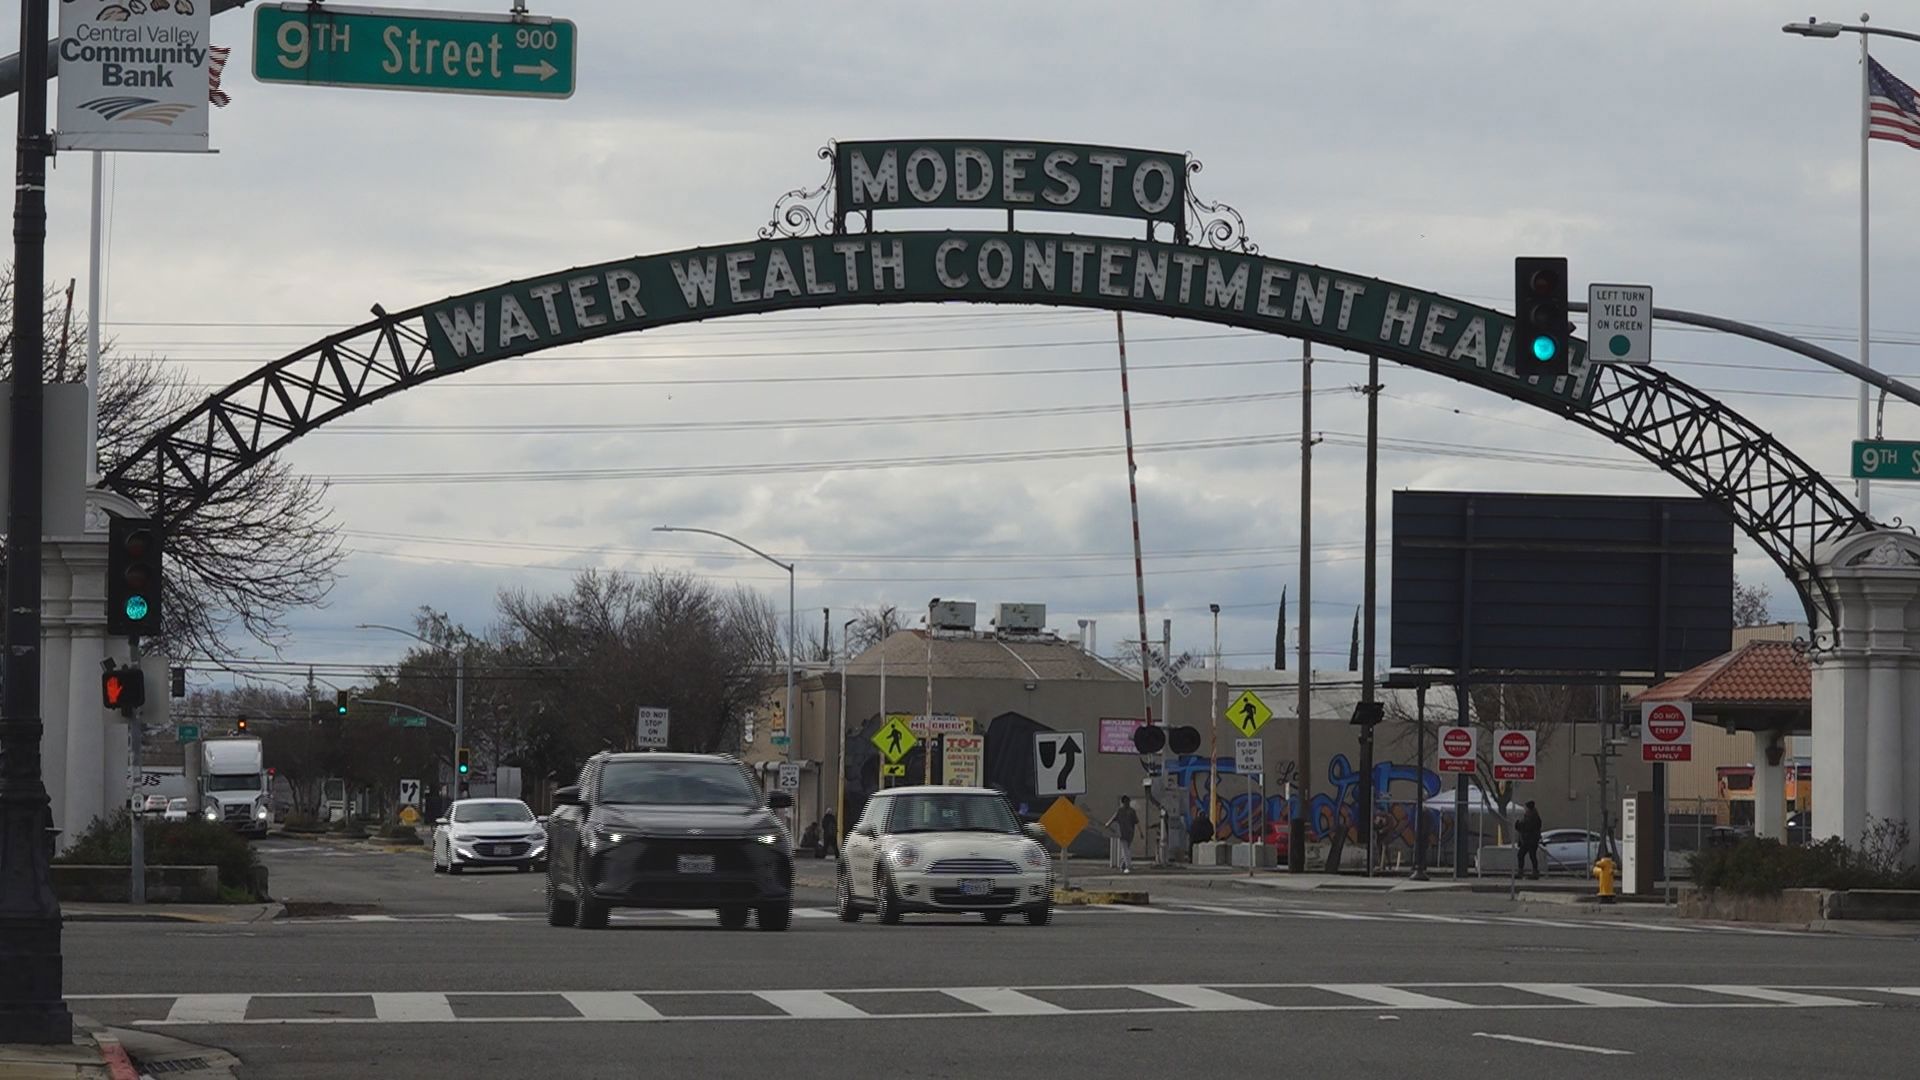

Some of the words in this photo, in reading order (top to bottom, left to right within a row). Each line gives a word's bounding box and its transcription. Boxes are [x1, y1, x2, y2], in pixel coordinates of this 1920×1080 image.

[76, 24, 141, 42] Central
[147, 26, 200, 45] Valley
[515, 29, 558, 51] 900
[60, 38, 206, 68] Community
[276, 20, 351, 69] 9TH
[381, 25, 502, 78] Street
[102, 63, 173, 87] Bank
[850, 147, 1175, 213] MODESTO
[435, 269, 647, 357] WATER
[670, 239, 906, 309] WEALTH
[935, 239, 1366, 332] CONTENTMENT
[1596, 290, 1618, 300] LEFT
[1622, 291, 1645, 301] TURN
[1604, 304, 1637, 317] YIELD
[1597, 320, 1610, 330] ON
[1613, 321, 1643, 331] GREEN
[1862, 448, 1898, 473] 9TH
[781, 776, 798, 787] 25
